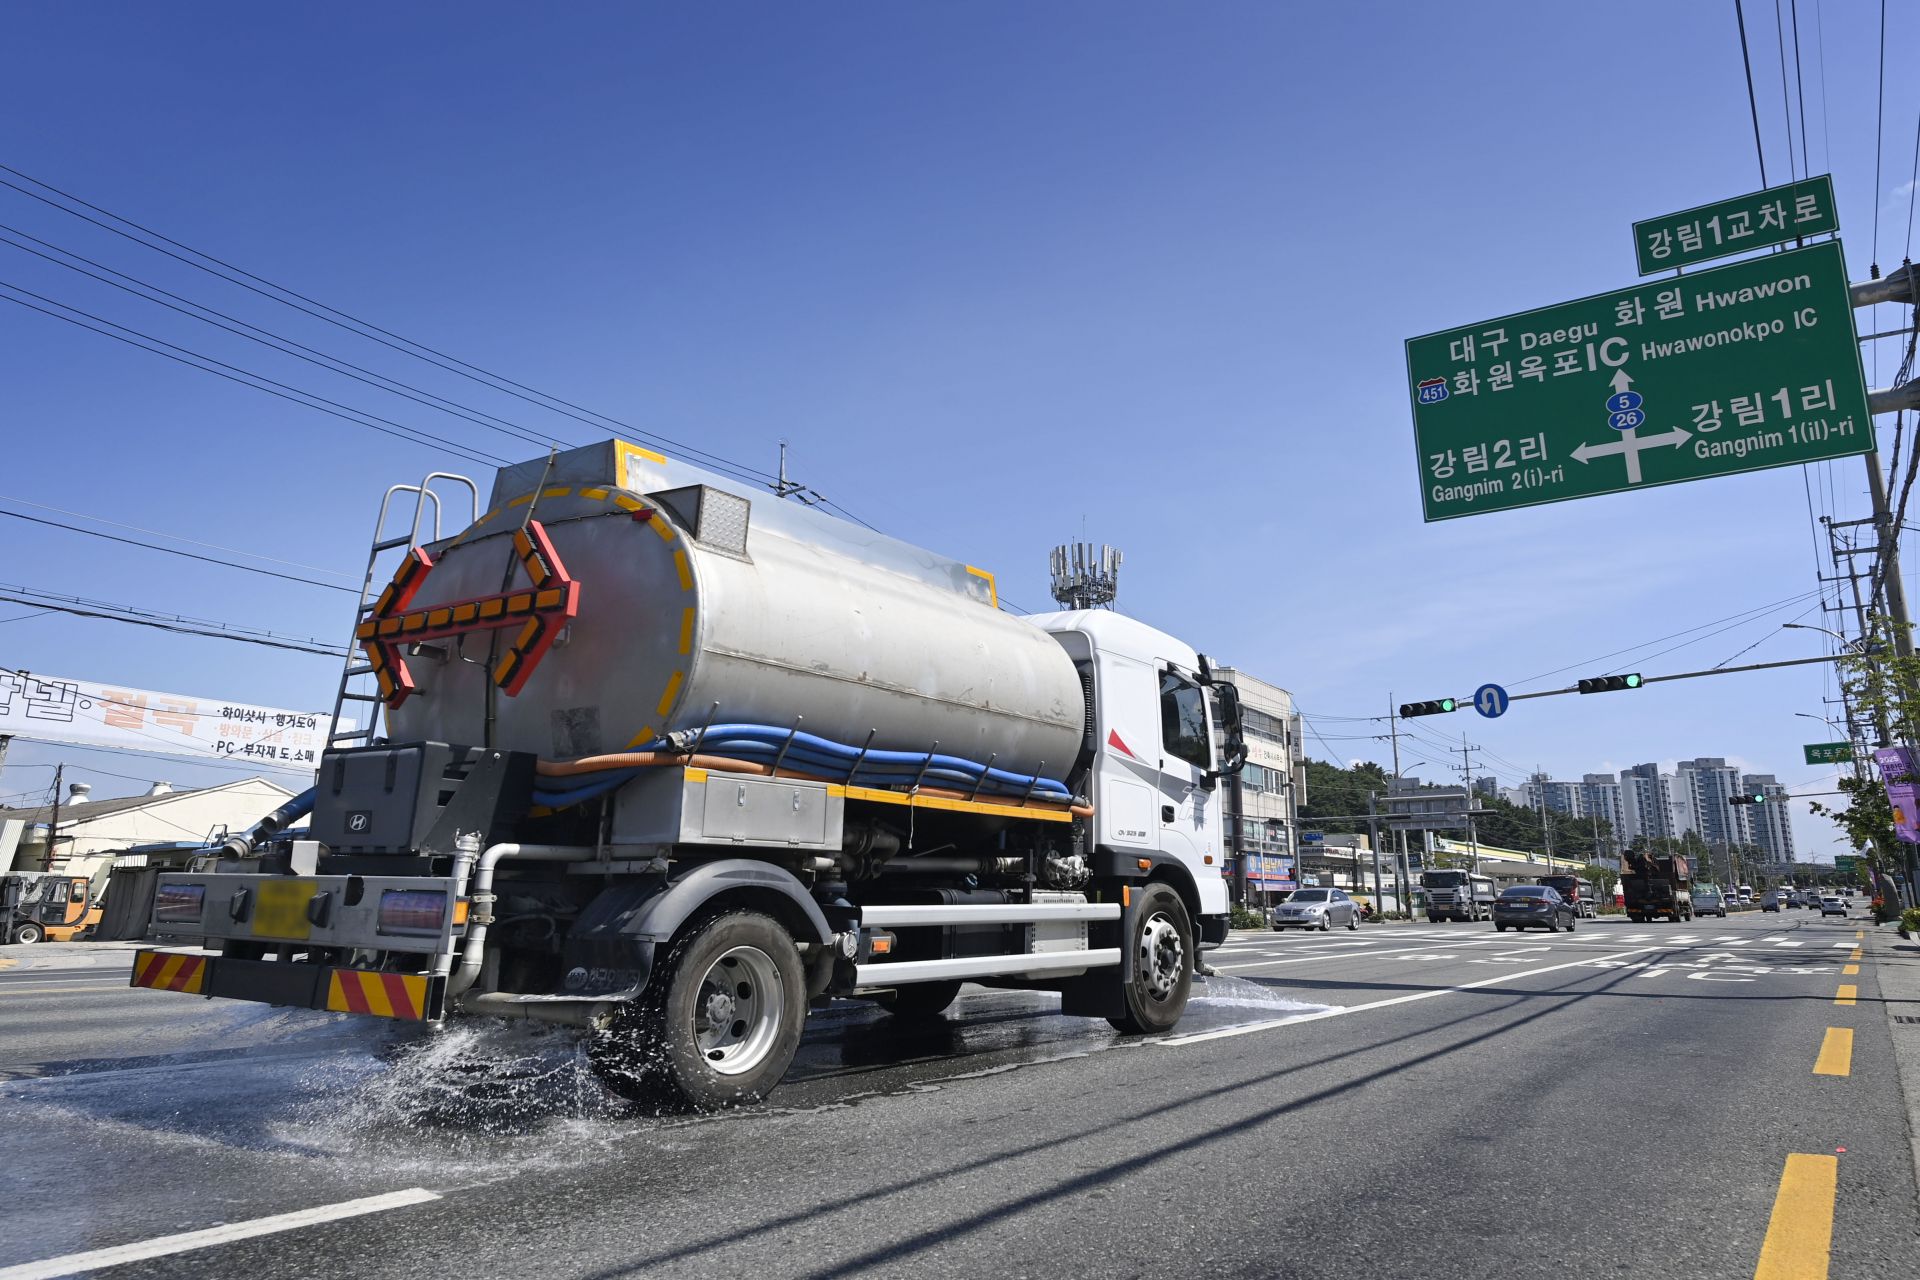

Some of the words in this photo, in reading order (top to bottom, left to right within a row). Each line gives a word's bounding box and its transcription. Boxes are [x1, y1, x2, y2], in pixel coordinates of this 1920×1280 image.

[1648, 194, 1823, 259] 강림1교차로
[1614, 287, 1684, 327] 화원
[1696, 274, 1811, 312] Hwawon
[1450, 328, 1509, 362] 대구
[1520, 319, 1599, 350] Daegu
[1641, 320, 1784, 361] Hwawonokpo
[1794, 307, 1818, 330] IC
[1453, 336, 1630, 396] 화원옥포IC
[1422, 386, 1444, 401] 451
[1619, 395, 1629, 408] 5
[1691, 379, 1837, 433] 강림1리
[1616, 413, 1637, 427] 26
[1694, 430, 1783, 459] Gangnim
[1788, 416, 1854, 444] 1(il)-ri
[1430, 432, 1548, 479] 강림2리
[1432, 477, 1504, 503] Gangnim
[1511, 465, 1564, 490] 2(i)-ri
[216, 741, 235, 753] PC
